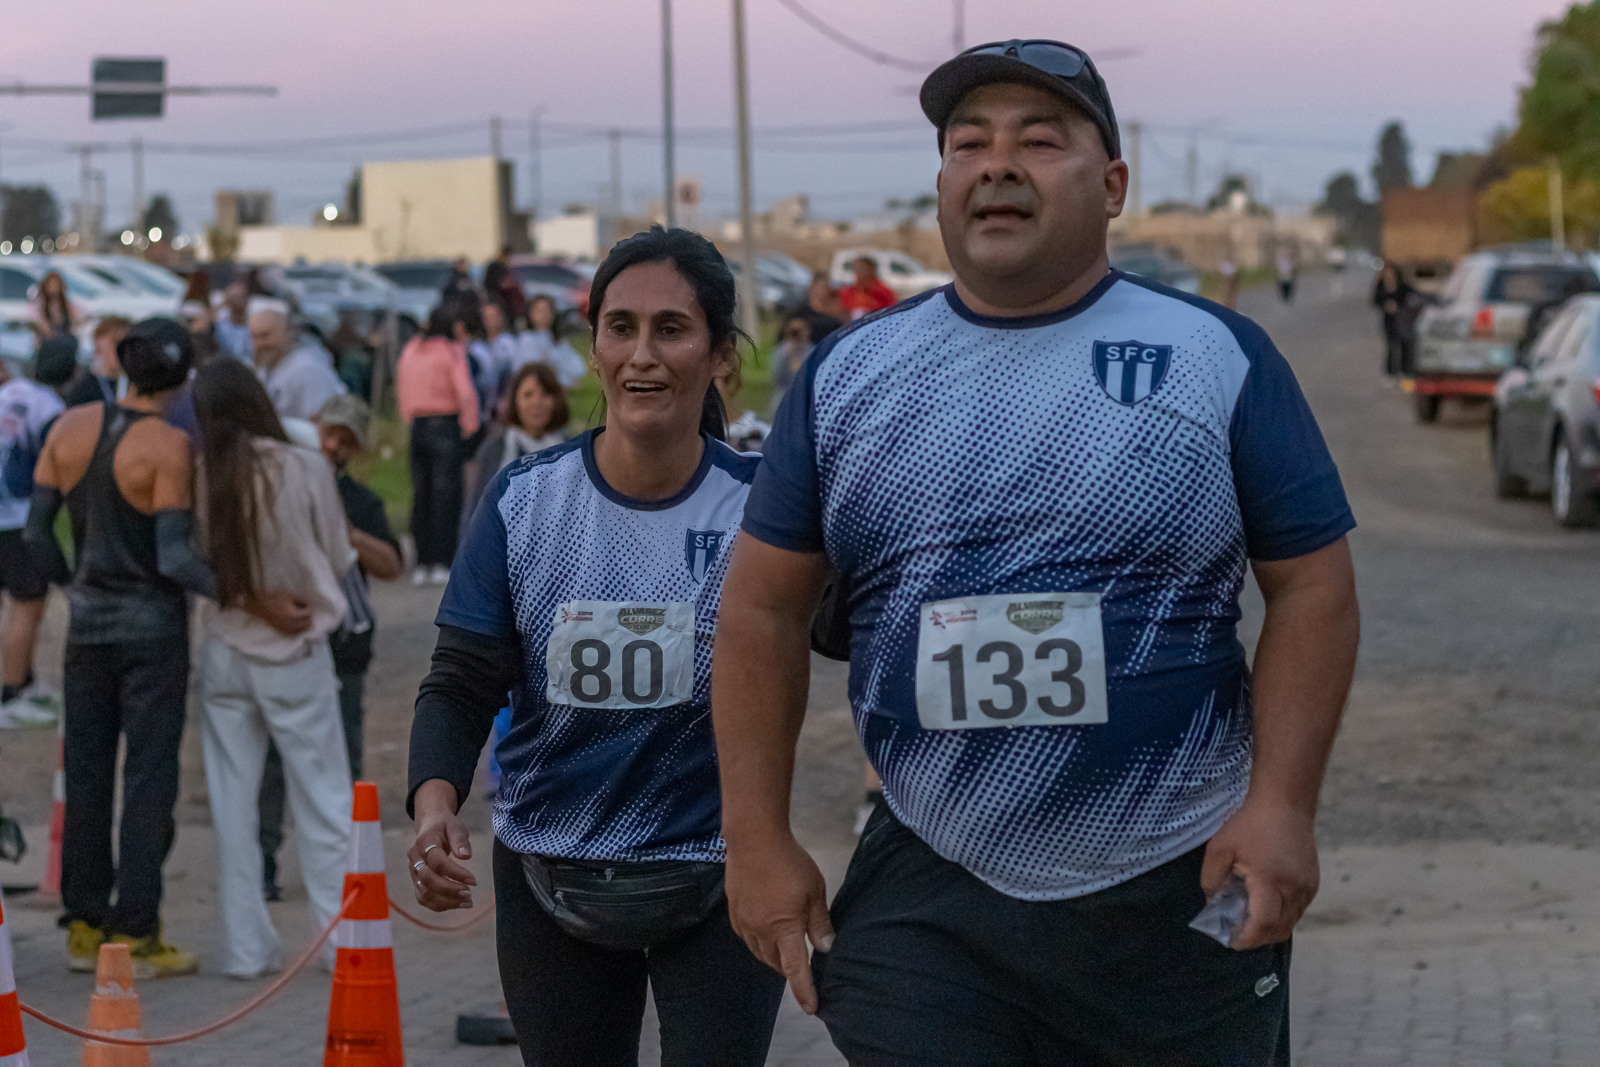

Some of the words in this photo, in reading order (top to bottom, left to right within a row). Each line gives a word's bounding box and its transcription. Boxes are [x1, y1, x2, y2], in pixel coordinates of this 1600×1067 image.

[1106, 345, 1158, 363] SFC
[617, 607, 667, 616] ALVAREZ
[620, 614, 665, 624] CORRE
[569, 638, 664, 705] 80
[931, 637, 1086, 722] 133
